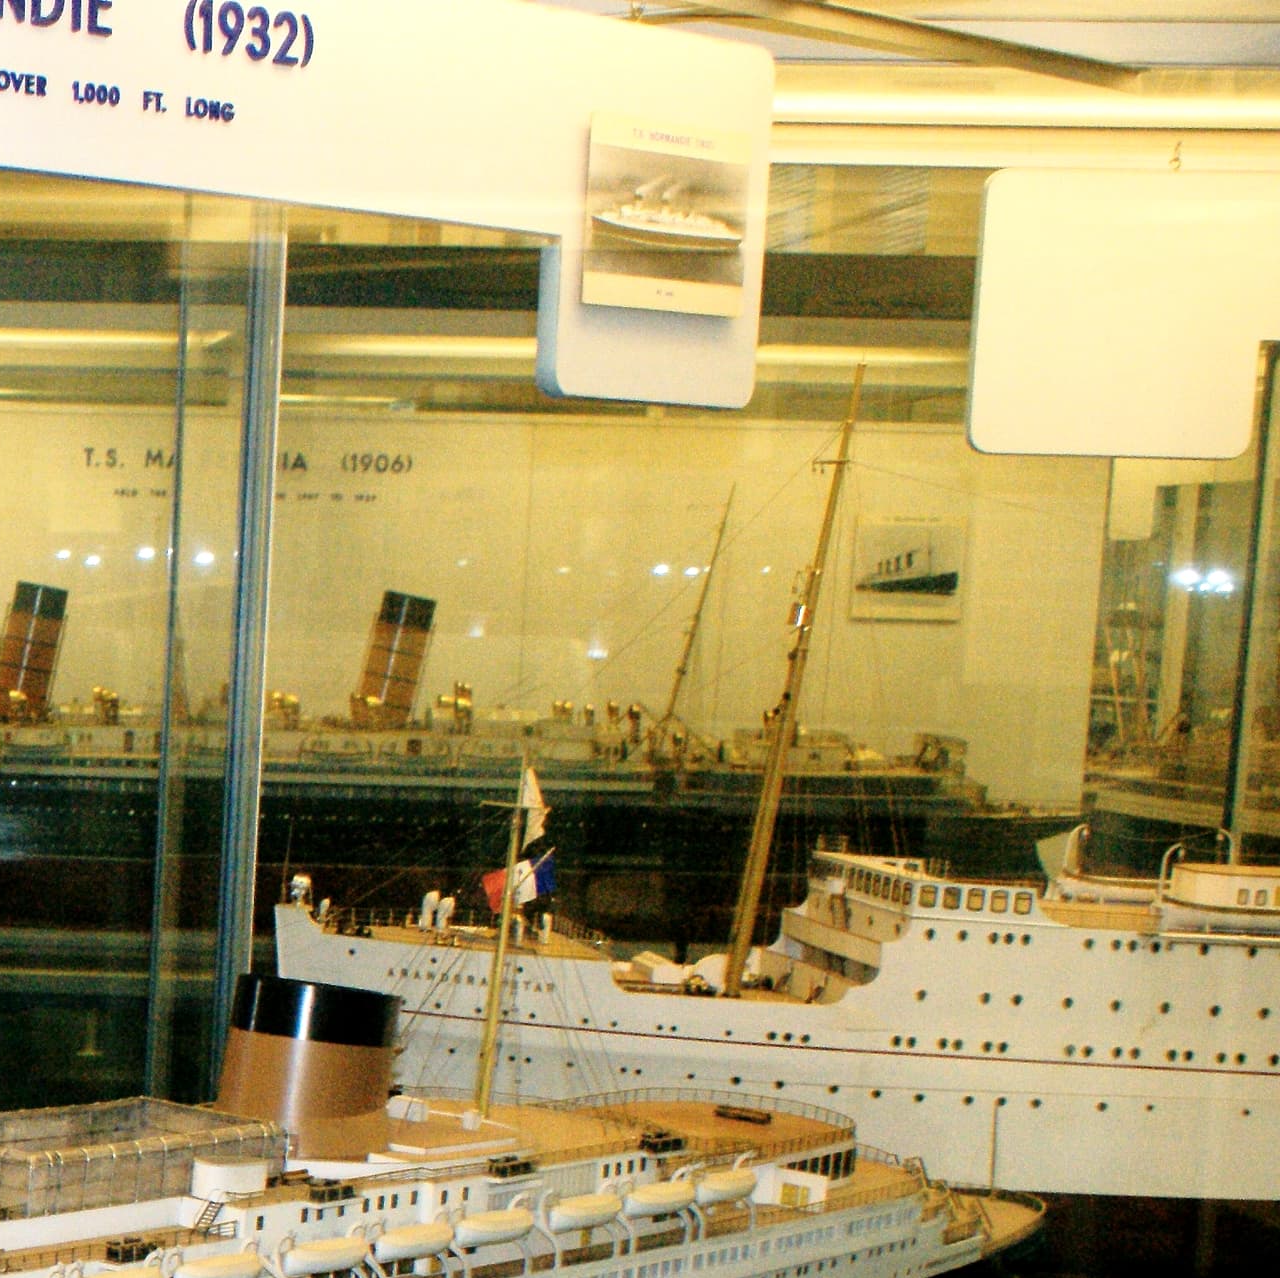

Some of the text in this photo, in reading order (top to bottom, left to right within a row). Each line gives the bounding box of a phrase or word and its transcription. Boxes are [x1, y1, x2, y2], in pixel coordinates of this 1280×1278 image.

[184, 0, 314, 68] (1932)
[72, 80, 121, 107] 1,000
[142, 90, 167, 113] FT.
[185, 96, 236, 122] LONG
[84, 447, 125, 468] T.S.
[342, 452, 413, 474] (1906)
